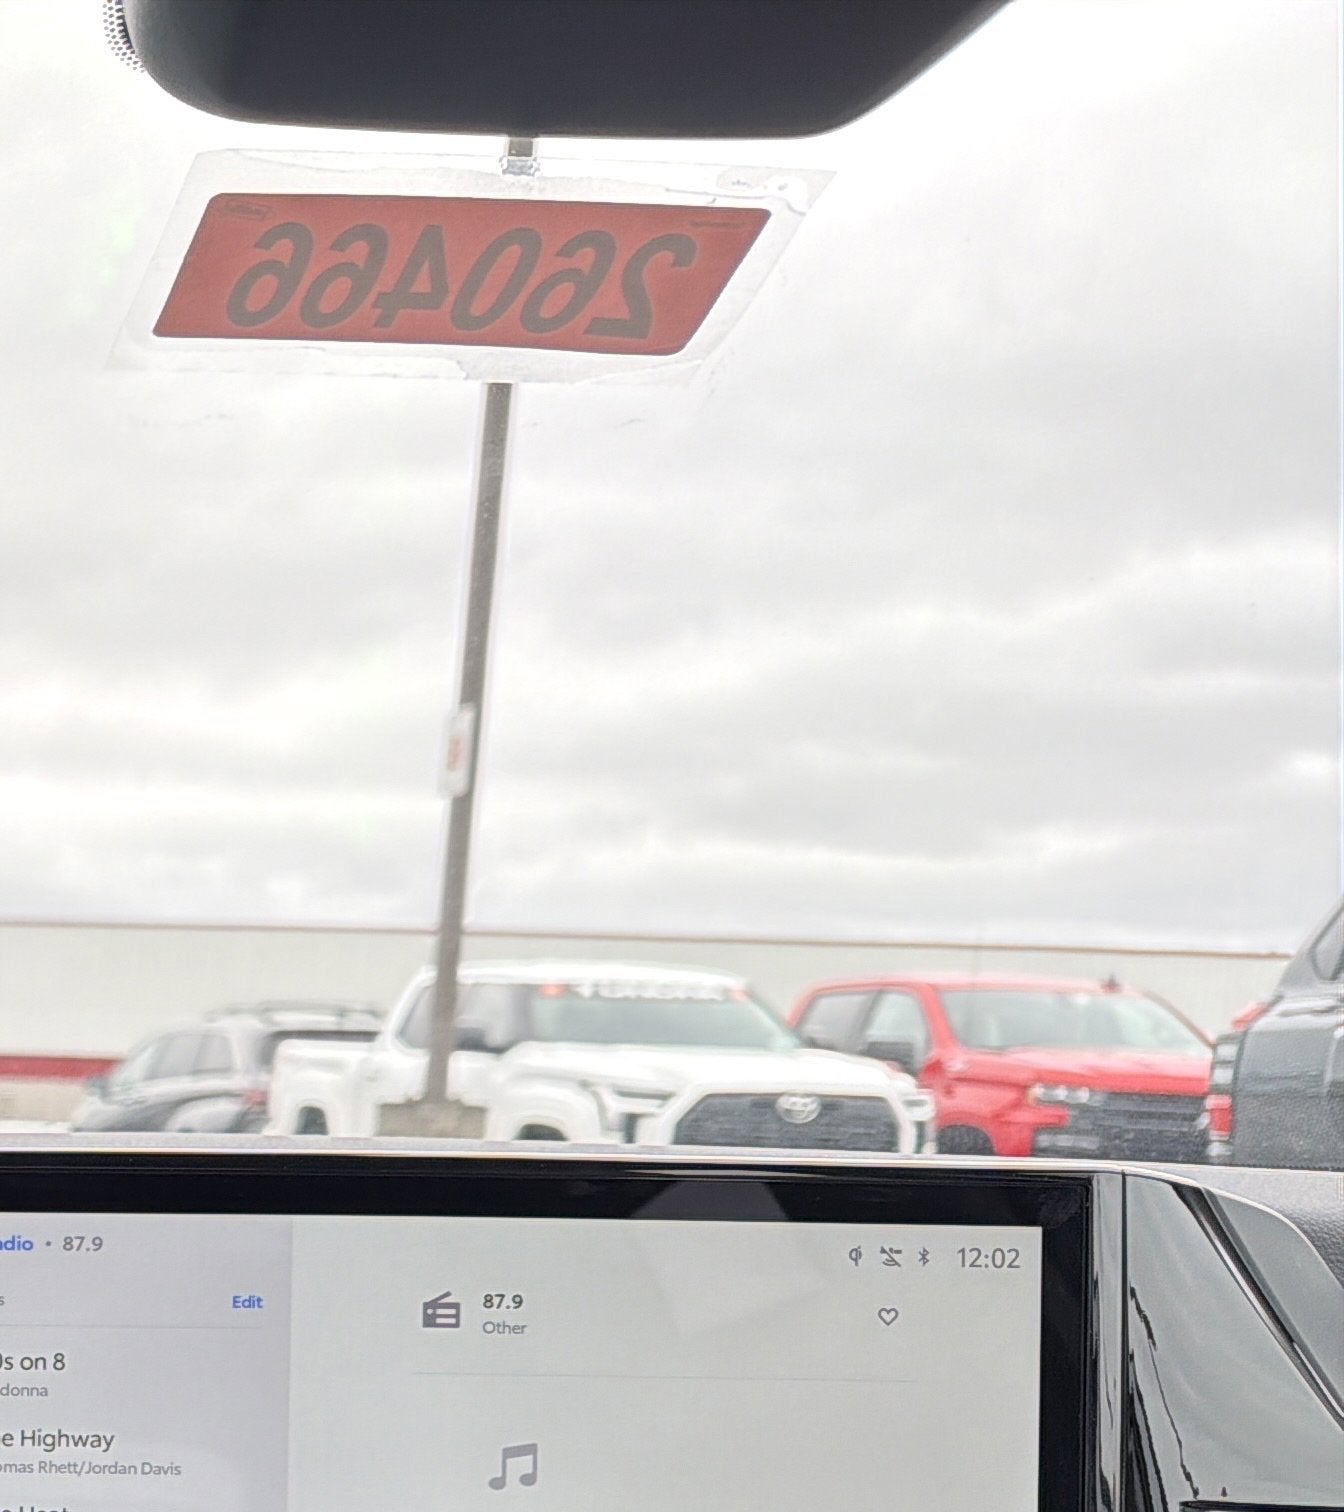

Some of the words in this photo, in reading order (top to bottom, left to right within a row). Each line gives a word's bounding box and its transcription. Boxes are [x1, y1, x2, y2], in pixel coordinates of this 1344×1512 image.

[62, 1236, 103, 1253] 87.9
[957, 1247, 1021, 1269] 12:02
[232, 1295, 263, 1309] Edit
[482, 1293, 524, 1310] 87.9
[482, 1320, 527, 1335] Other
[20, 1357, 47, 1371] on
[53, 1353, 66, 1371] 8
[20, 1429, 115, 1453] Highway
[38, 1460, 138, 1476] Rhett/Jordan
[140, 1462, 182, 1476] Davis
